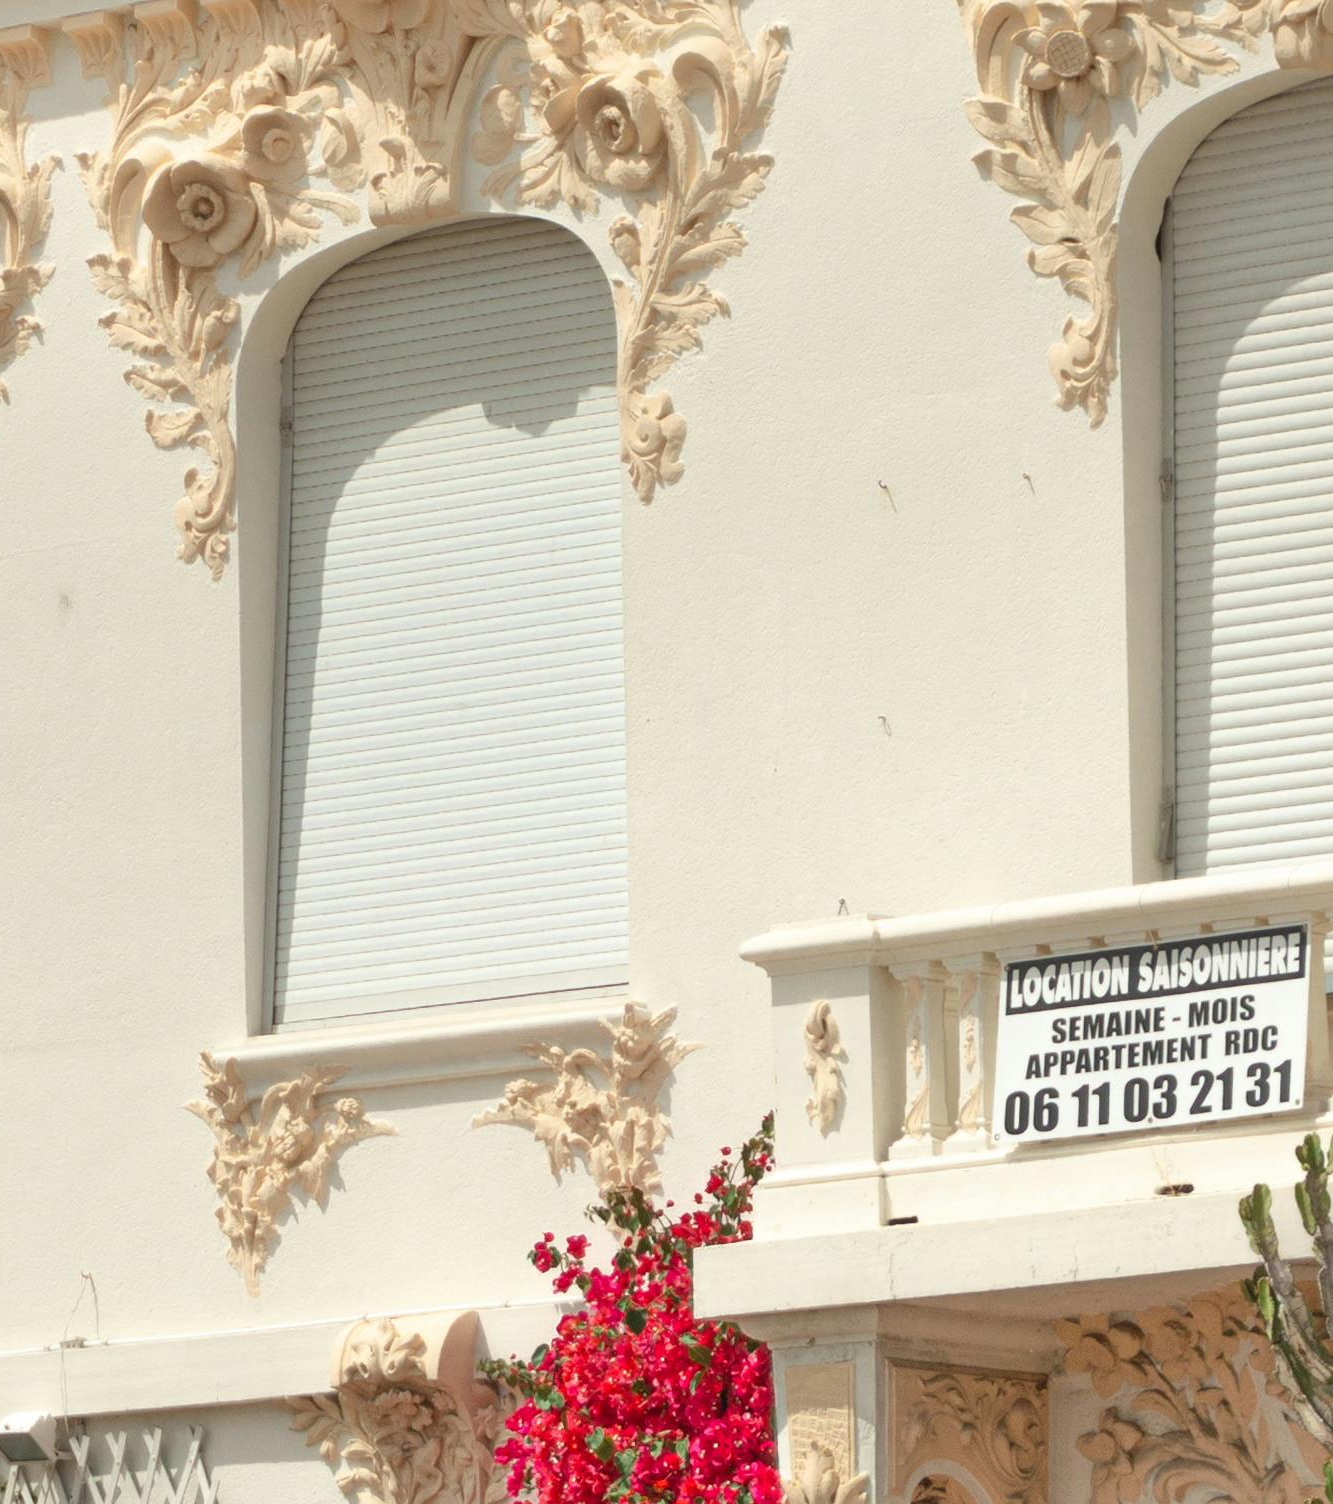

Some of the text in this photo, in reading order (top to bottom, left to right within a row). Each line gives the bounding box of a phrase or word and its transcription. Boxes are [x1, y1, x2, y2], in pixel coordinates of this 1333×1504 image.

[1010, 932, 1301, 1009] LOCATION SAISONNIERE
[1052, 1006, 1165, 1044] SEMAINE
[1188, 994, 1255, 1028] MOIS
[1025, 1025, 1279, 1080] APPARTEMENT RDC
[1004, 1059, 1292, 1135] 06 11 03 21 31
